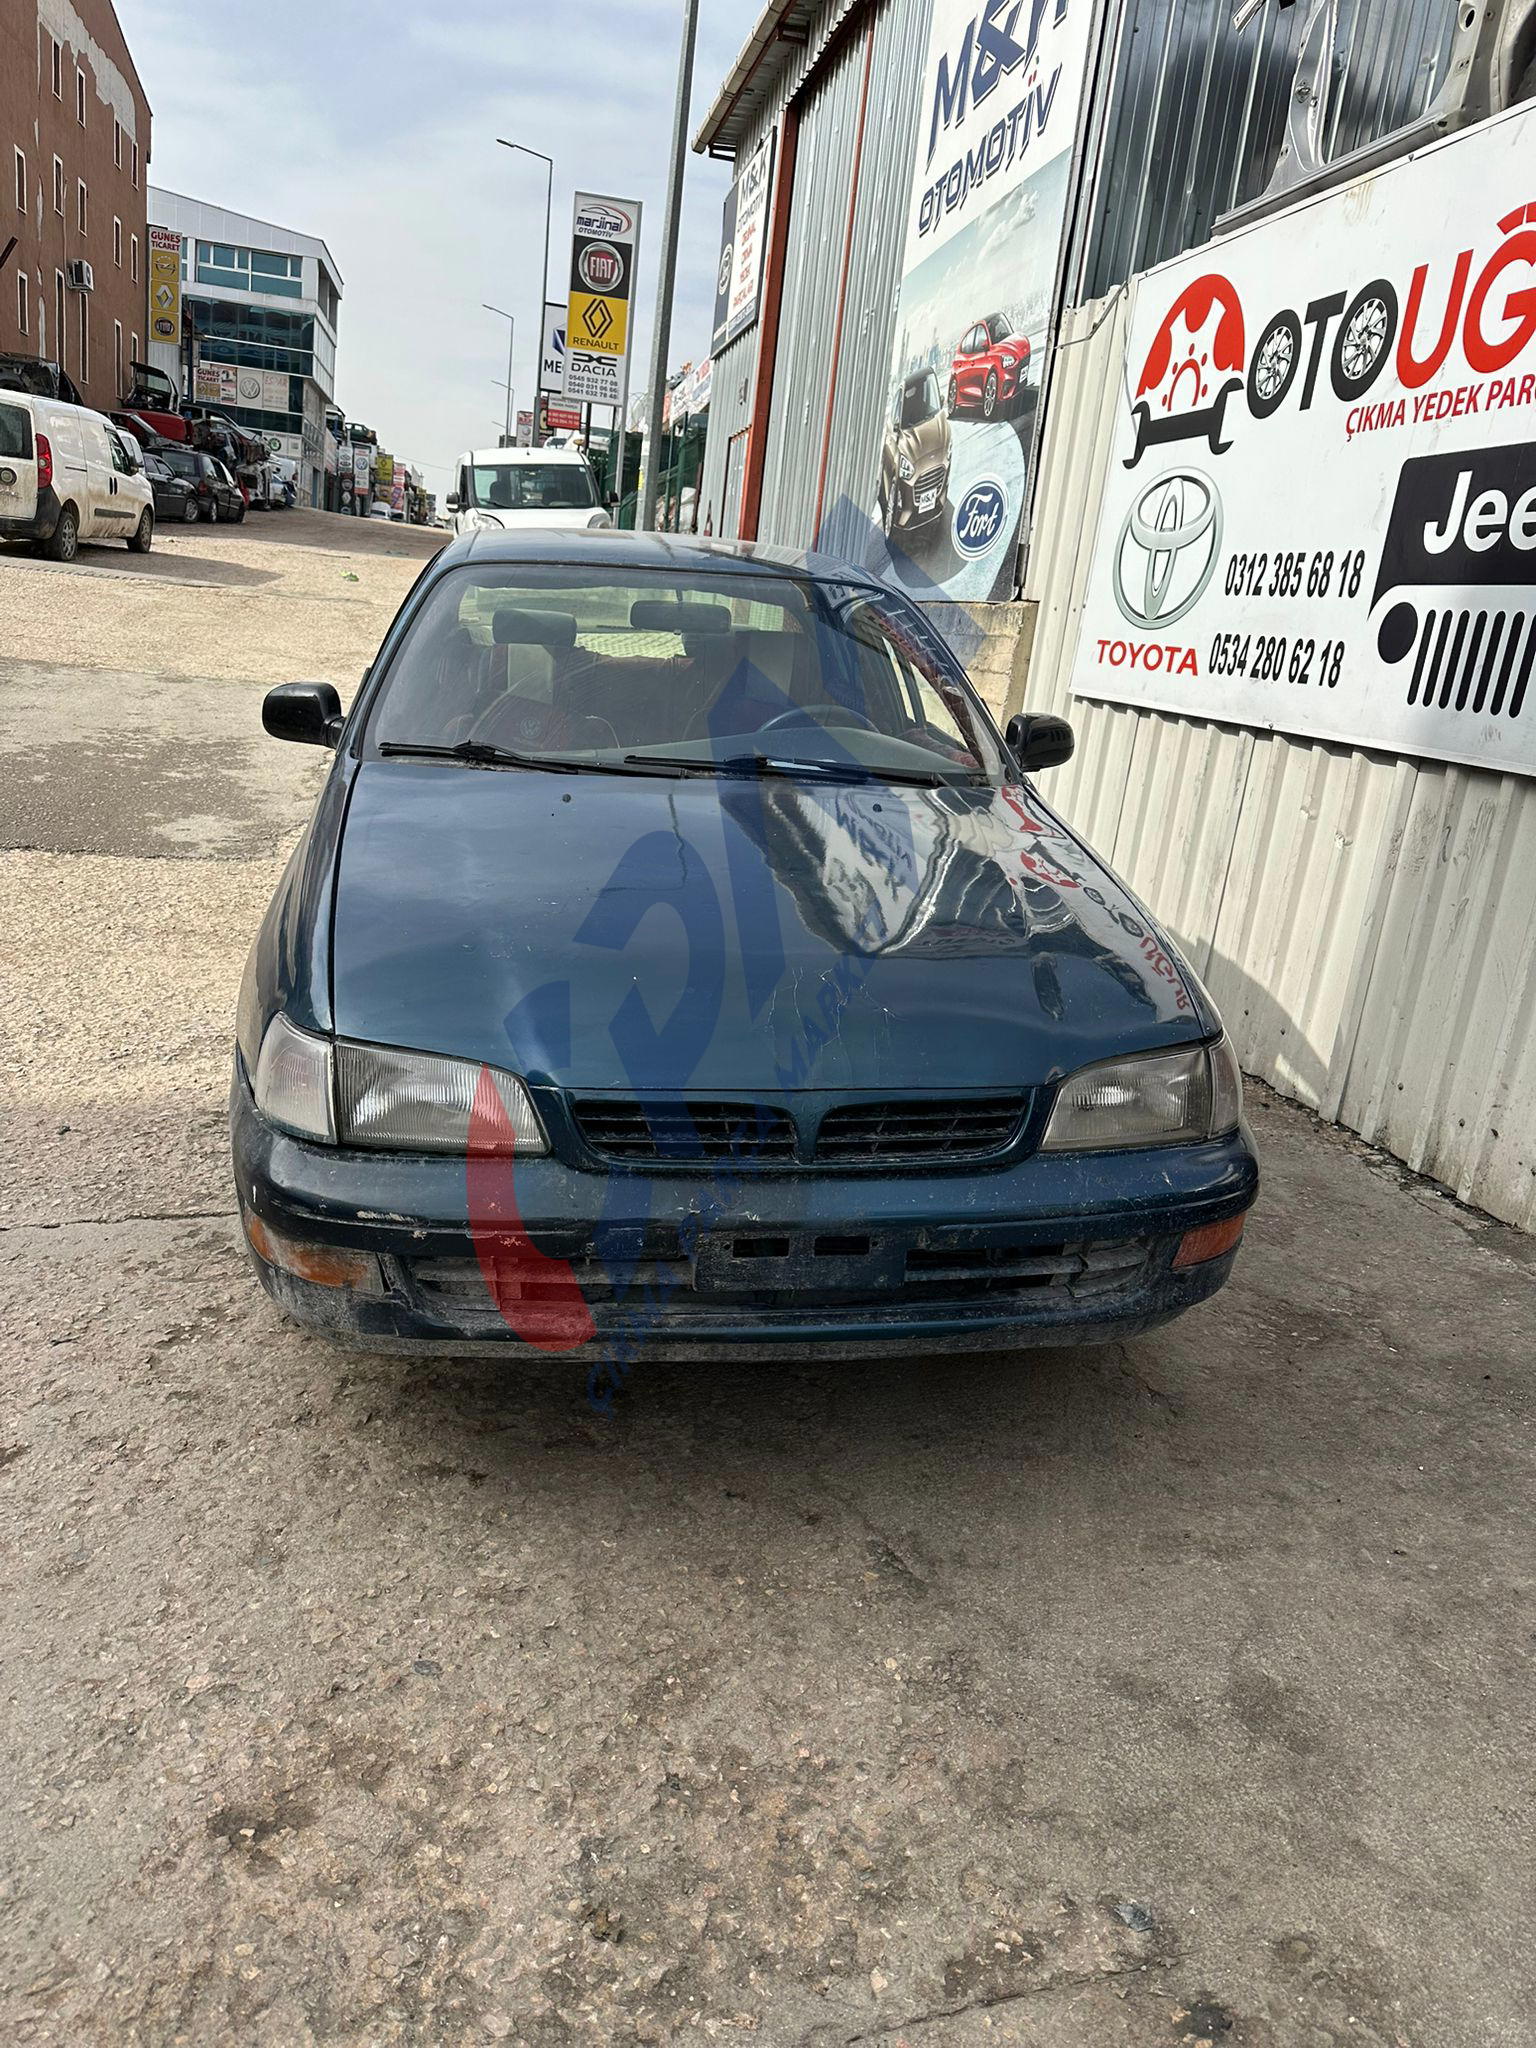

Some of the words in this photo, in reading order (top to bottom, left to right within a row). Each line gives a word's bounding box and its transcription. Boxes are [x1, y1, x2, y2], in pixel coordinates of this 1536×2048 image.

[589, 256, 614, 279] FIAT
[573, 337, 619, 350] RENAULT
[571, 363, 617, 378] DACIA
[1346, 398, 1406, 442] ÇIKMA
[1413, 383, 1485, 423] YEDEK
[1485, 373, 1536, 411] PAR
[1225, 553, 1267, 596] 0312
[1269, 552, 1306, 597] 385
[1307, 551, 1334, 597] 68
[1338, 549, 1365, 598] 18
[1097, 640, 1198, 676] TOYOTA
[1209, 633, 1251, 677] 0534
[1250, 635, 1286, 681] 280
[1289, 638, 1315, 684] 62
[1319, 640, 1345, 688] 18
